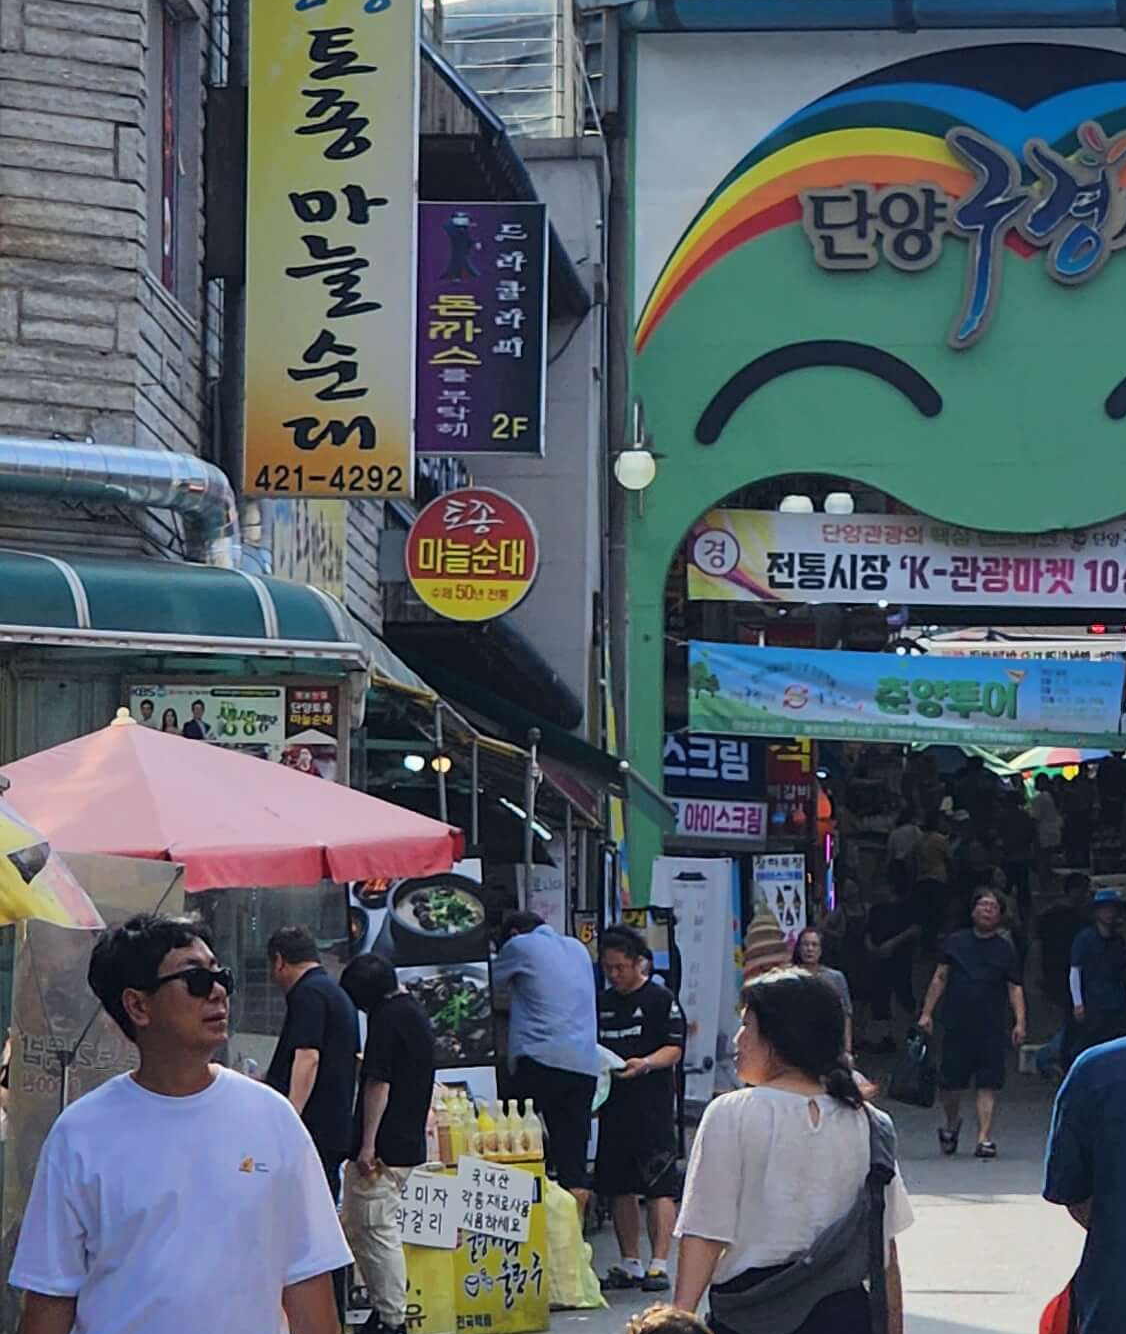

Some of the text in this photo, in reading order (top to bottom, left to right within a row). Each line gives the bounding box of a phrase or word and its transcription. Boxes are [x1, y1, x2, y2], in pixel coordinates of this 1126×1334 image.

[296, 27, 377, 159] 토종
[491, 413, 528, 440] 2F
[255, 465, 402, 492] 421-4292
[443, 499, 504, 534] 토종
[822, 523, 924, 545] 단양관광의
[418, 538, 526, 575] 마늘순대
[703, 538, 727, 569] 경
[766, 552, 891, 591] 전통시장
[456, 584, 484, 601] 50년
[290, 714, 333, 726] 마늘순대
[684, 803, 762, 836] 아이스크림
[472, 1168, 510, 1190] 국내산
